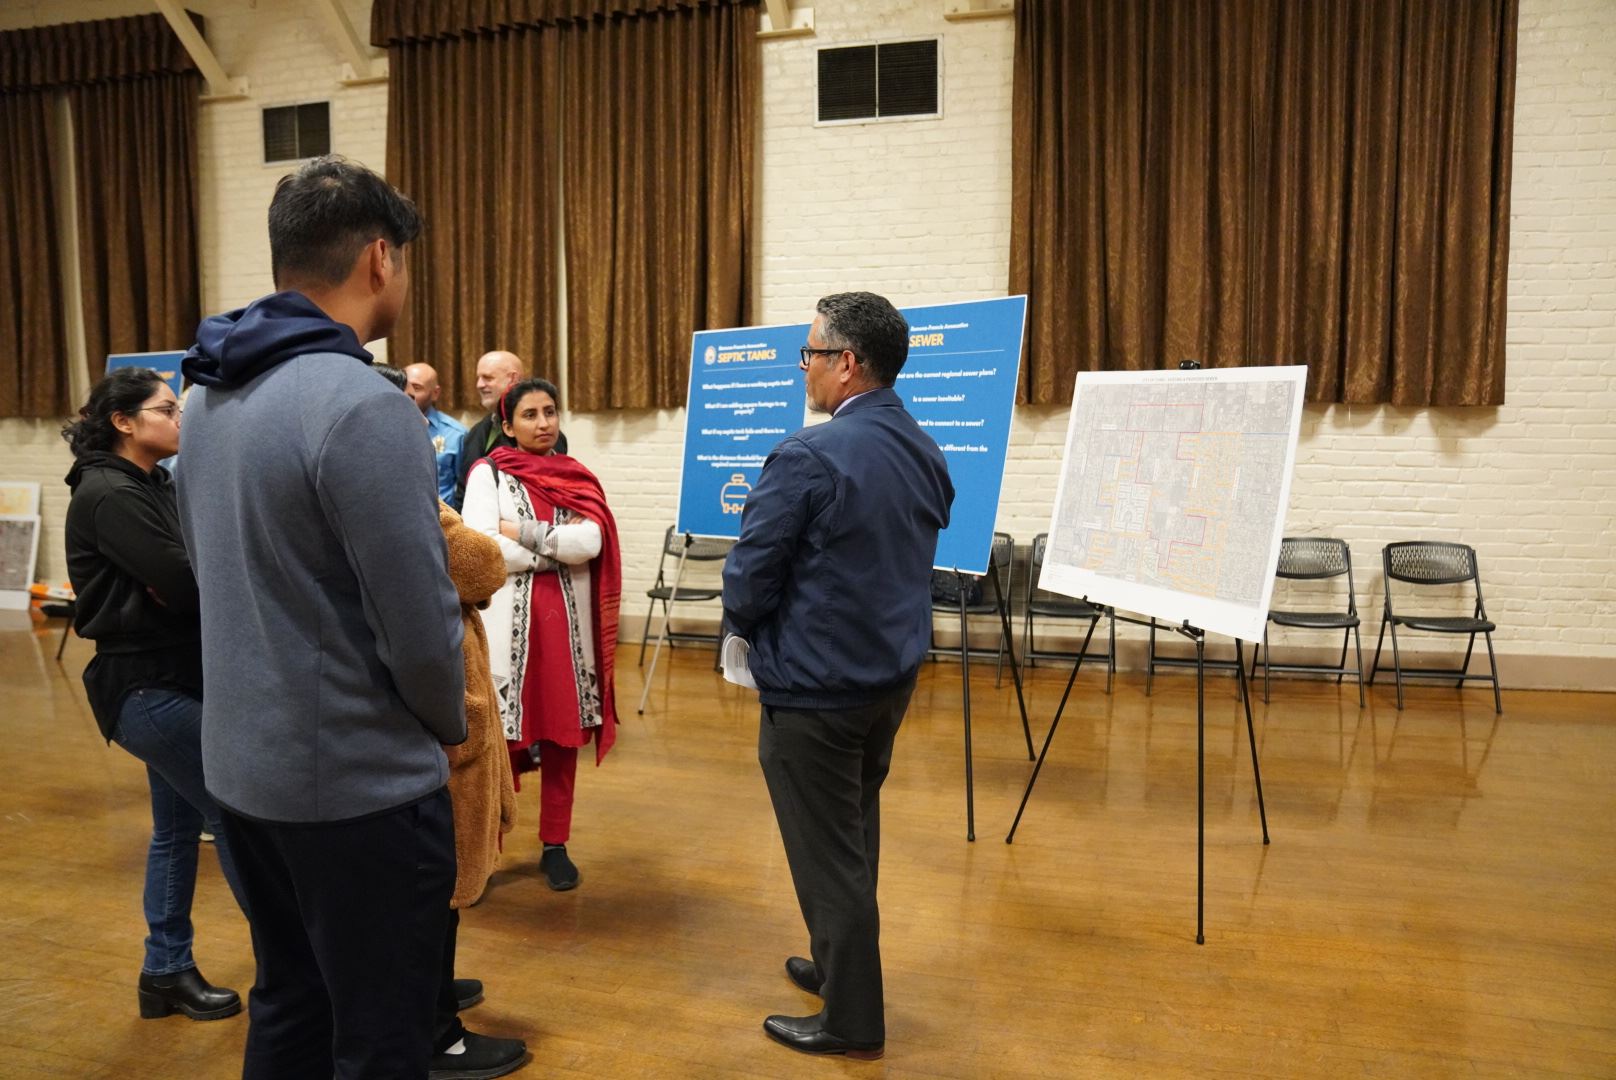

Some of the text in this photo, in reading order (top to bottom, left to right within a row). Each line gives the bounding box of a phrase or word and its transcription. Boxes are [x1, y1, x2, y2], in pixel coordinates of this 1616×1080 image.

[908, 334, 944, 348] SEWER
[717, 349, 777, 363] SEPTIC TANKS
